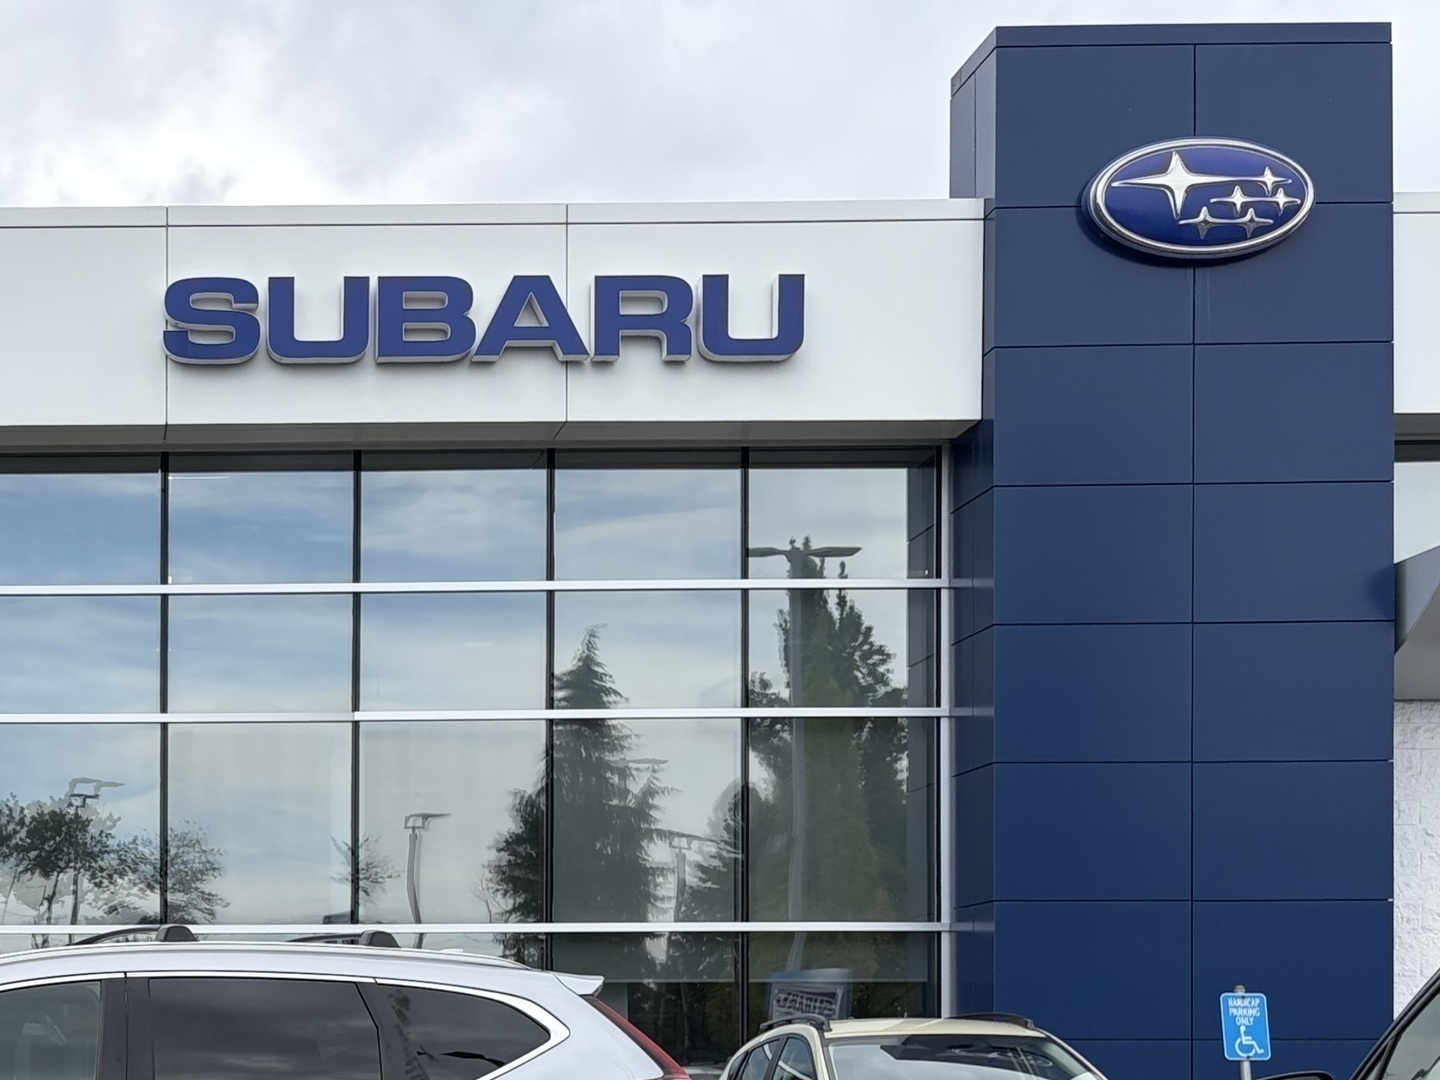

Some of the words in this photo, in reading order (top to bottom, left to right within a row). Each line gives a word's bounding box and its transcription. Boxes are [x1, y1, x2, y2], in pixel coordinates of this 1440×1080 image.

[163, 275, 806, 364] SUBARU
[1227, 997, 1260, 1007] HANDICAP
[1228, 1007, 1261, 1017] PARKING
[1235, 1016, 1255, 1026] ONLY
